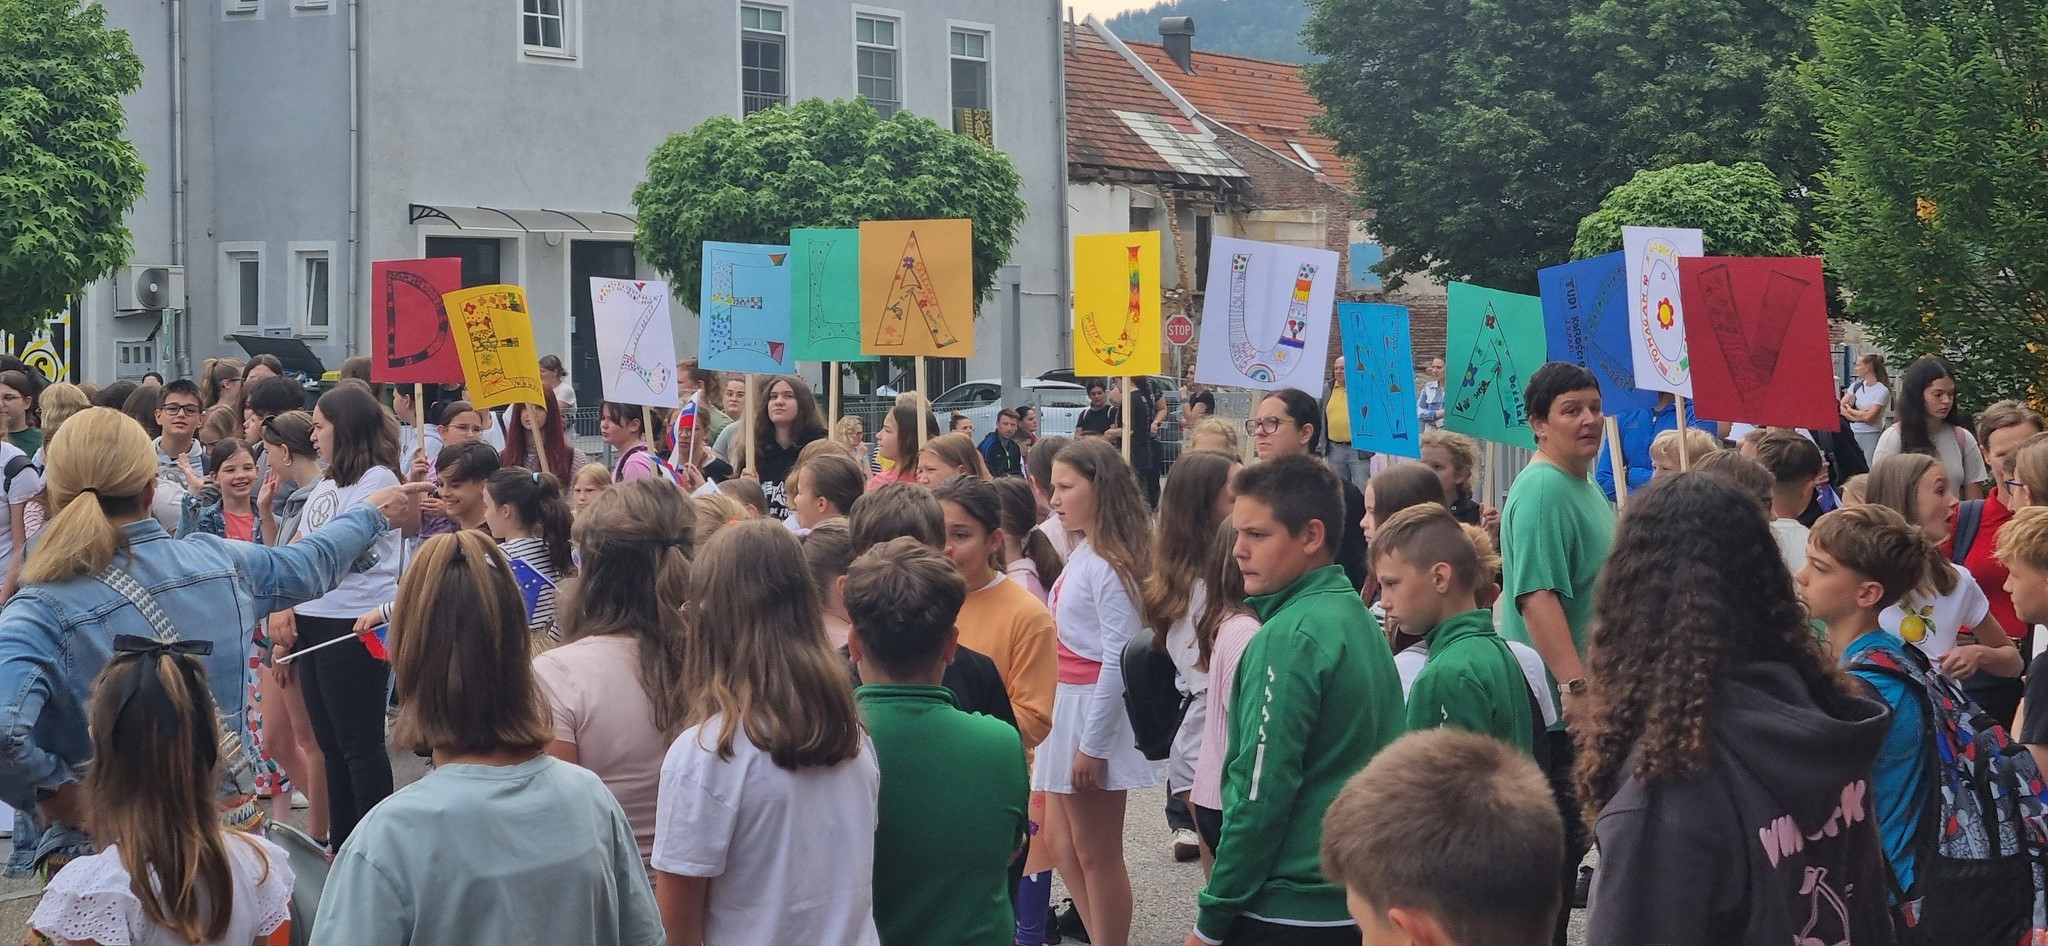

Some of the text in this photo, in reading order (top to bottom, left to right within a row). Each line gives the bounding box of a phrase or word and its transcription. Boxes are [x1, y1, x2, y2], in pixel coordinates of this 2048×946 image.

[386, 270, 448, 368] D
[459, 292, 539, 398] E
[709, 249, 787, 366] E
[874, 230, 958, 349] A
[1081, 246, 1141, 366] J
[1168, 324, 1191, 336] STOP
[1229, 253, 1319, 382] U
[1565, 278, 1578, 310] TUDI
[1697, 263, 1809, 412] V
[1350, 312, 1408, 440] N
[1451, 300, 1530, 428] A
